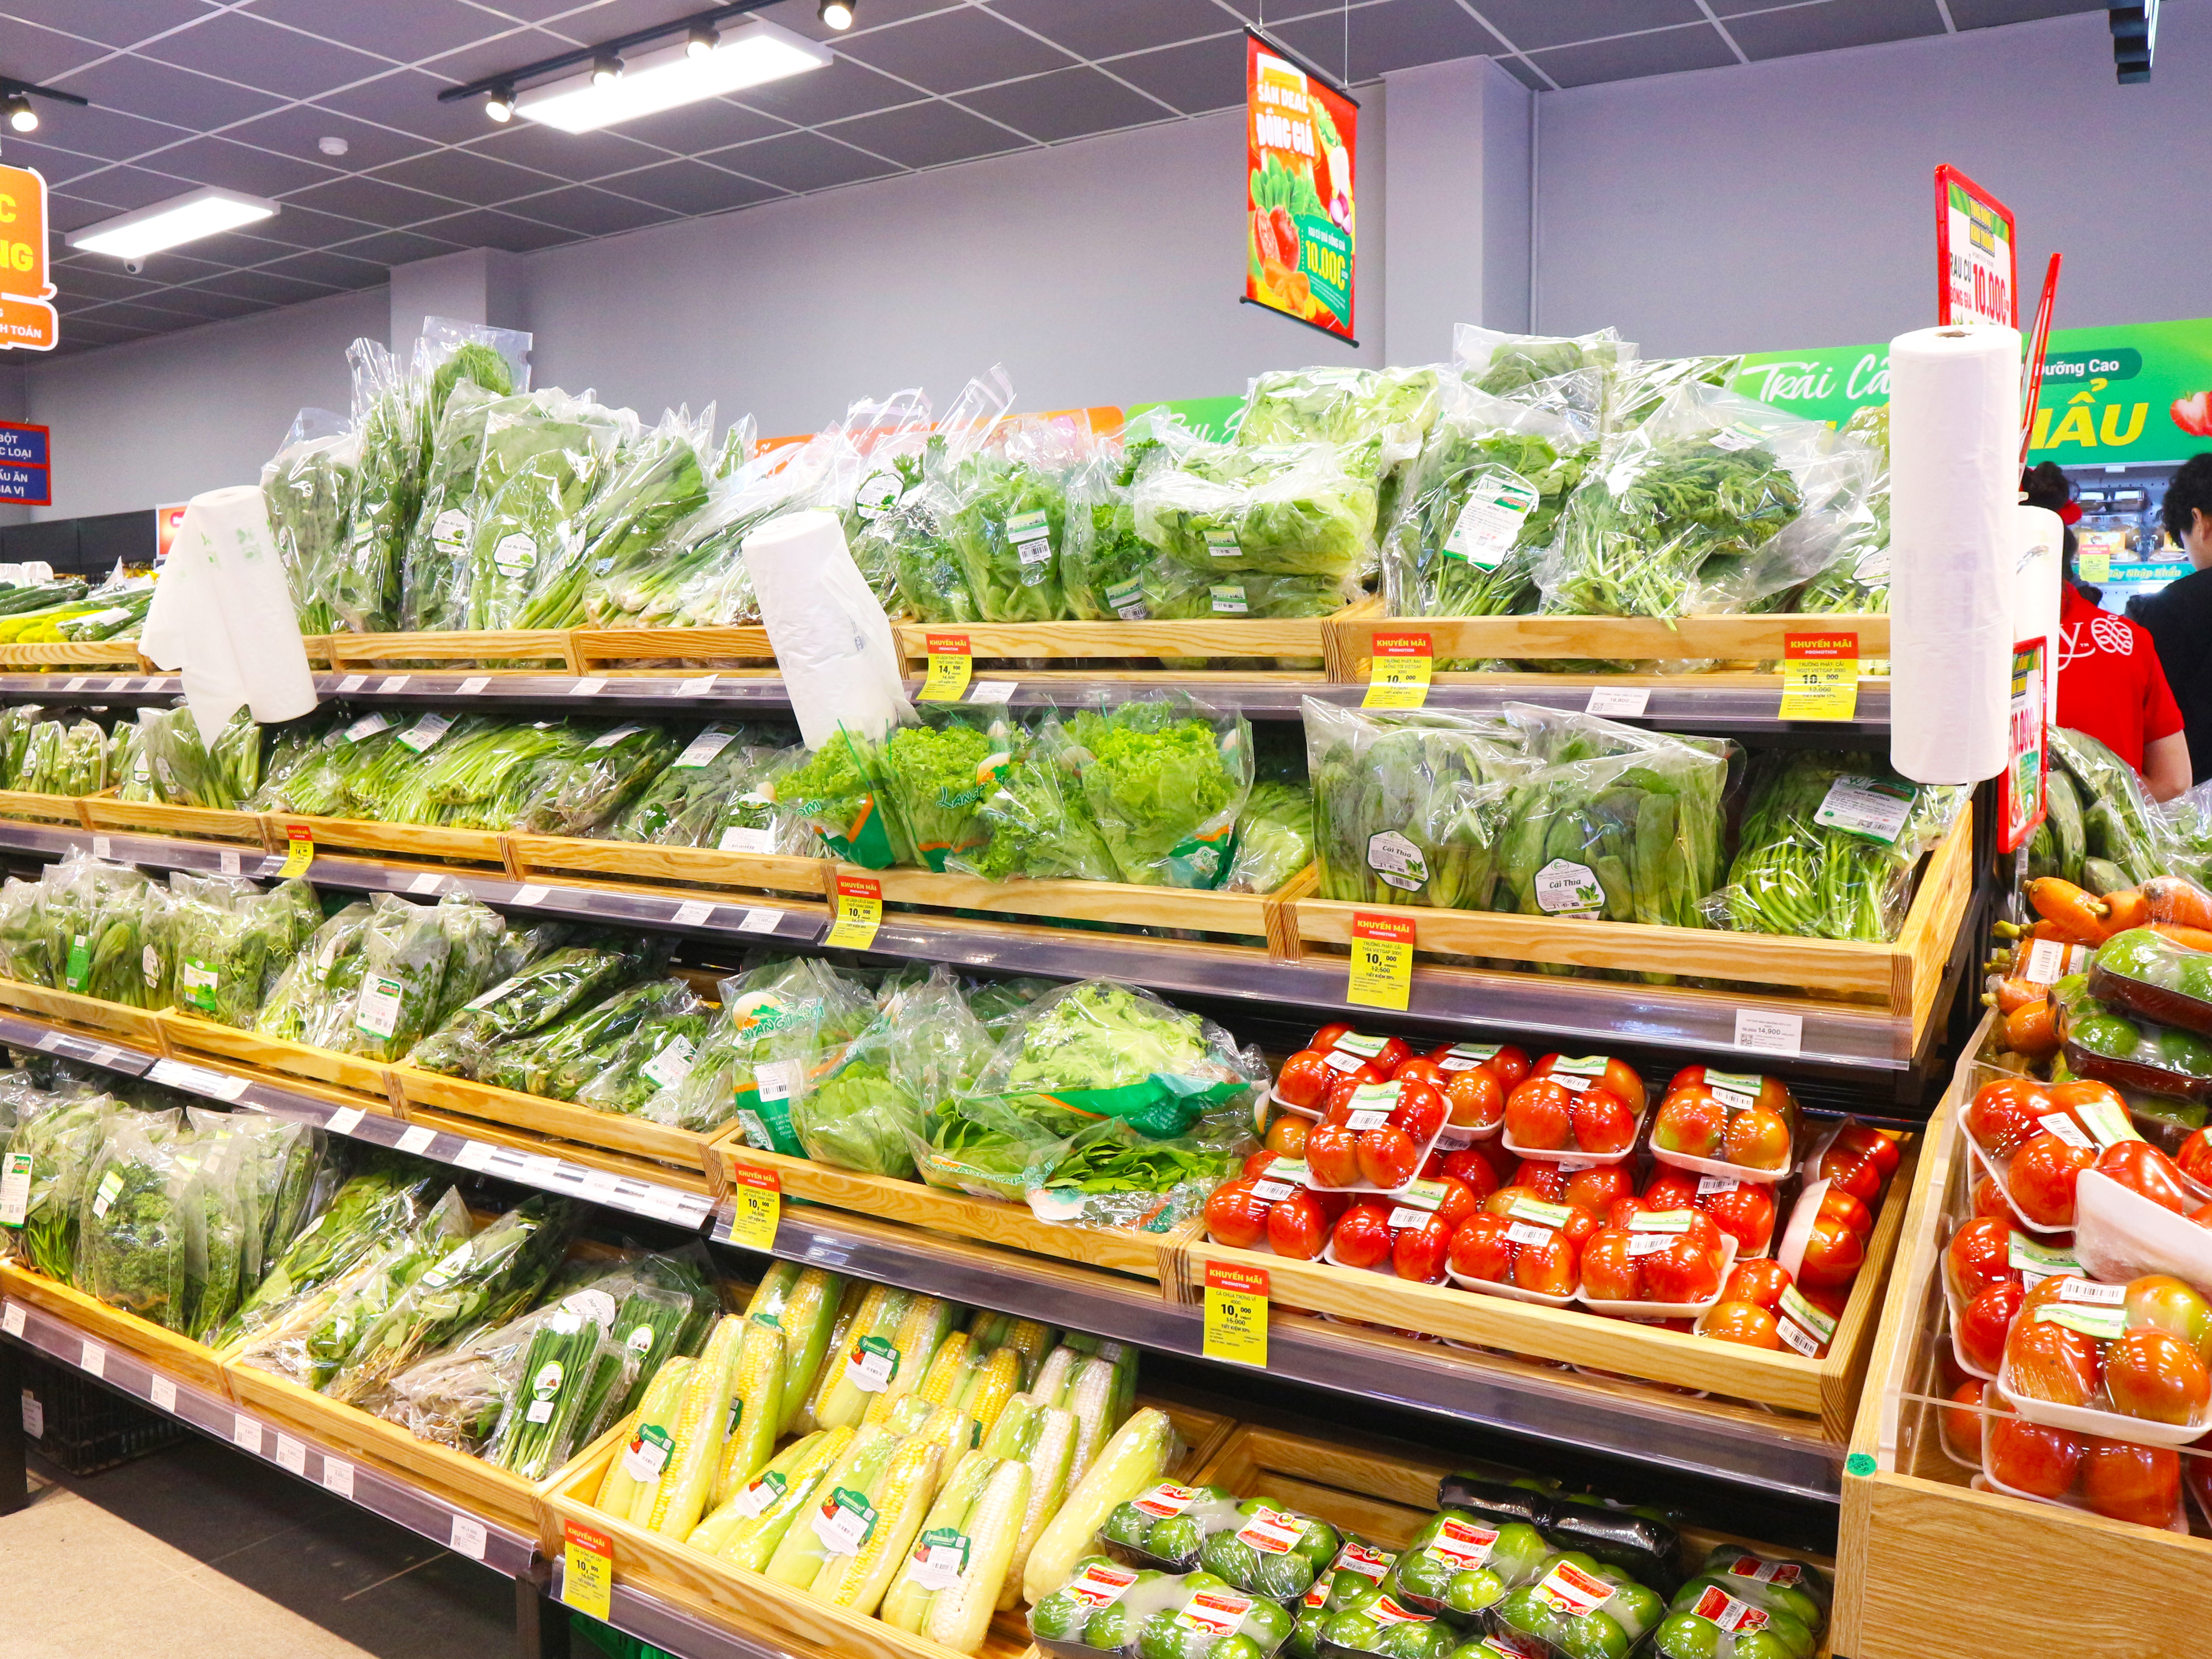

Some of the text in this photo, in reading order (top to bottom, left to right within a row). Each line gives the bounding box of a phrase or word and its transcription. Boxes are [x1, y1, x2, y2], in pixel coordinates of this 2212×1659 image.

[1257, 82, 1309, 114] SĂN DEAL
[1256, 107, 1315, 157] ĐỒNG GIÁ
[1950, 252, 1962, 279] RAU
[10, 325, 42, 338] TOÁN
[2089, 359, 2119, 373] Cao
[1742, 352, 1891, 402] Trái Câ
[8, 447, 32, 459] LOẠI
[13, 470, 28, 483] ĂN
[0, 484, 24, 497] IA VỊ
[1377, 638, 1426, 647] KHUYẾN MÃI
[1791, 638, 1852, 648] KHUYẾN MÃI
[841, 881, 865, 890] KHUYẾN
[1357, 920, 1409, 933] KHUYẾN MÃI
[1366, 953, 1382, 966] 10,
[1758, 1027, 1781, 1035] 14,900
[738, 1169, 775, 1183] KHUYẾN MÃI
[748, 1198, 759, 1211] 10,
[1209, 1269, 1262, 1285] KHUYẾN MÃI
[1221, 1280, 1250, 1288] PROMOTION
[1221, 1303, 1238, 1318] 10,
[1226, 1317, 1246, 1326] 15,000
[567, 1527, 605, 1548] KHUYẾN MÃI
